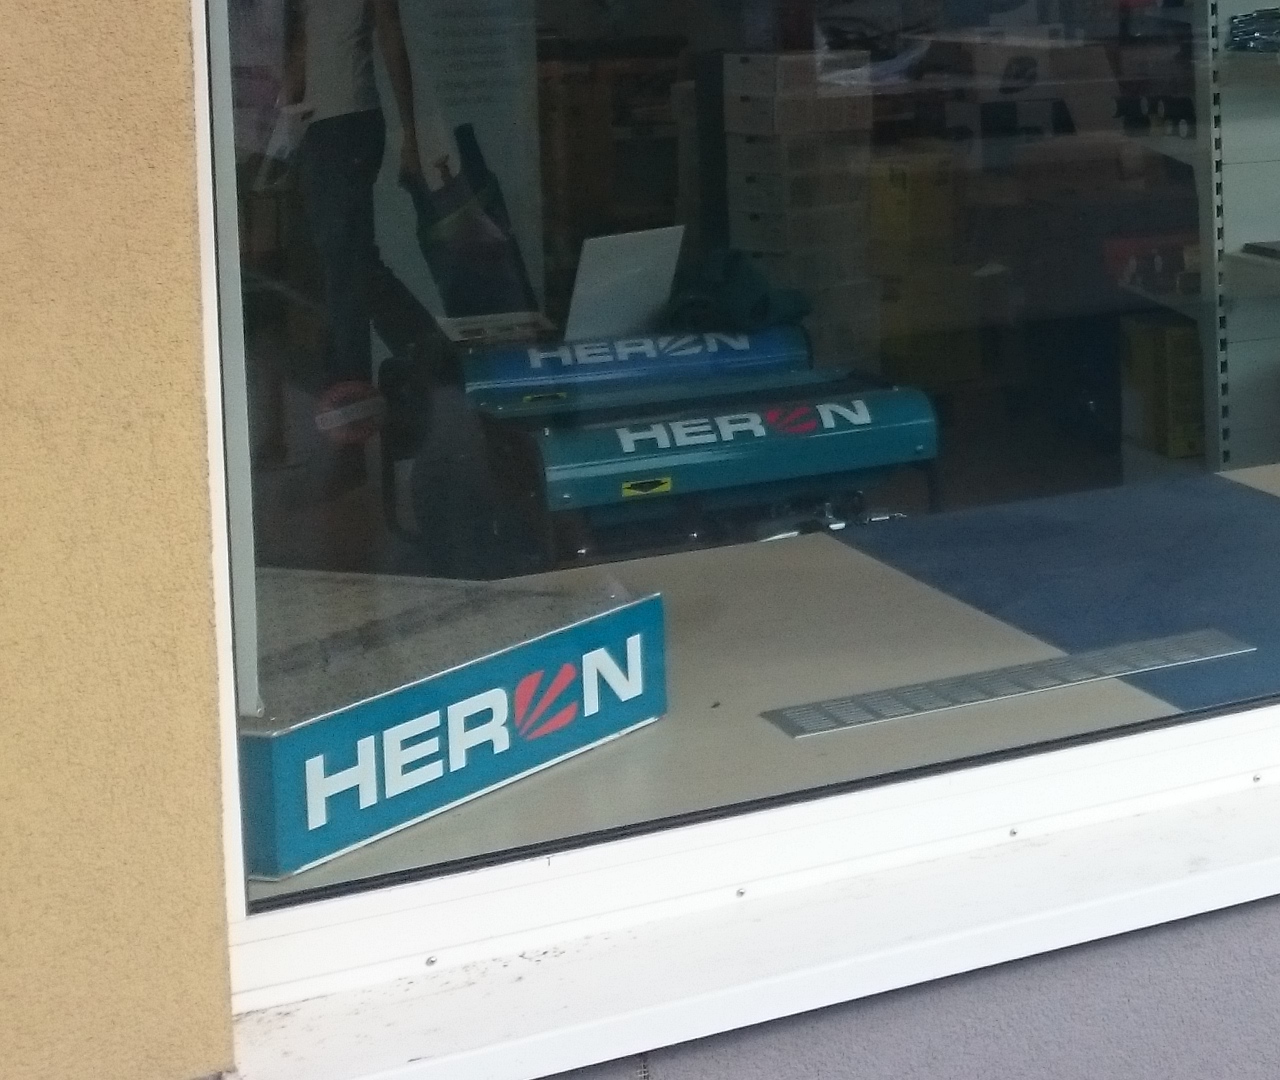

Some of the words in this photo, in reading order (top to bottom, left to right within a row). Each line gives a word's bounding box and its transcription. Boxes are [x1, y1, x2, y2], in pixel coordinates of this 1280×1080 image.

[527, 331, 751, 368] HERON
[616, 398, 872, 453] HERON
[305, 633, 643, 831] HERON
